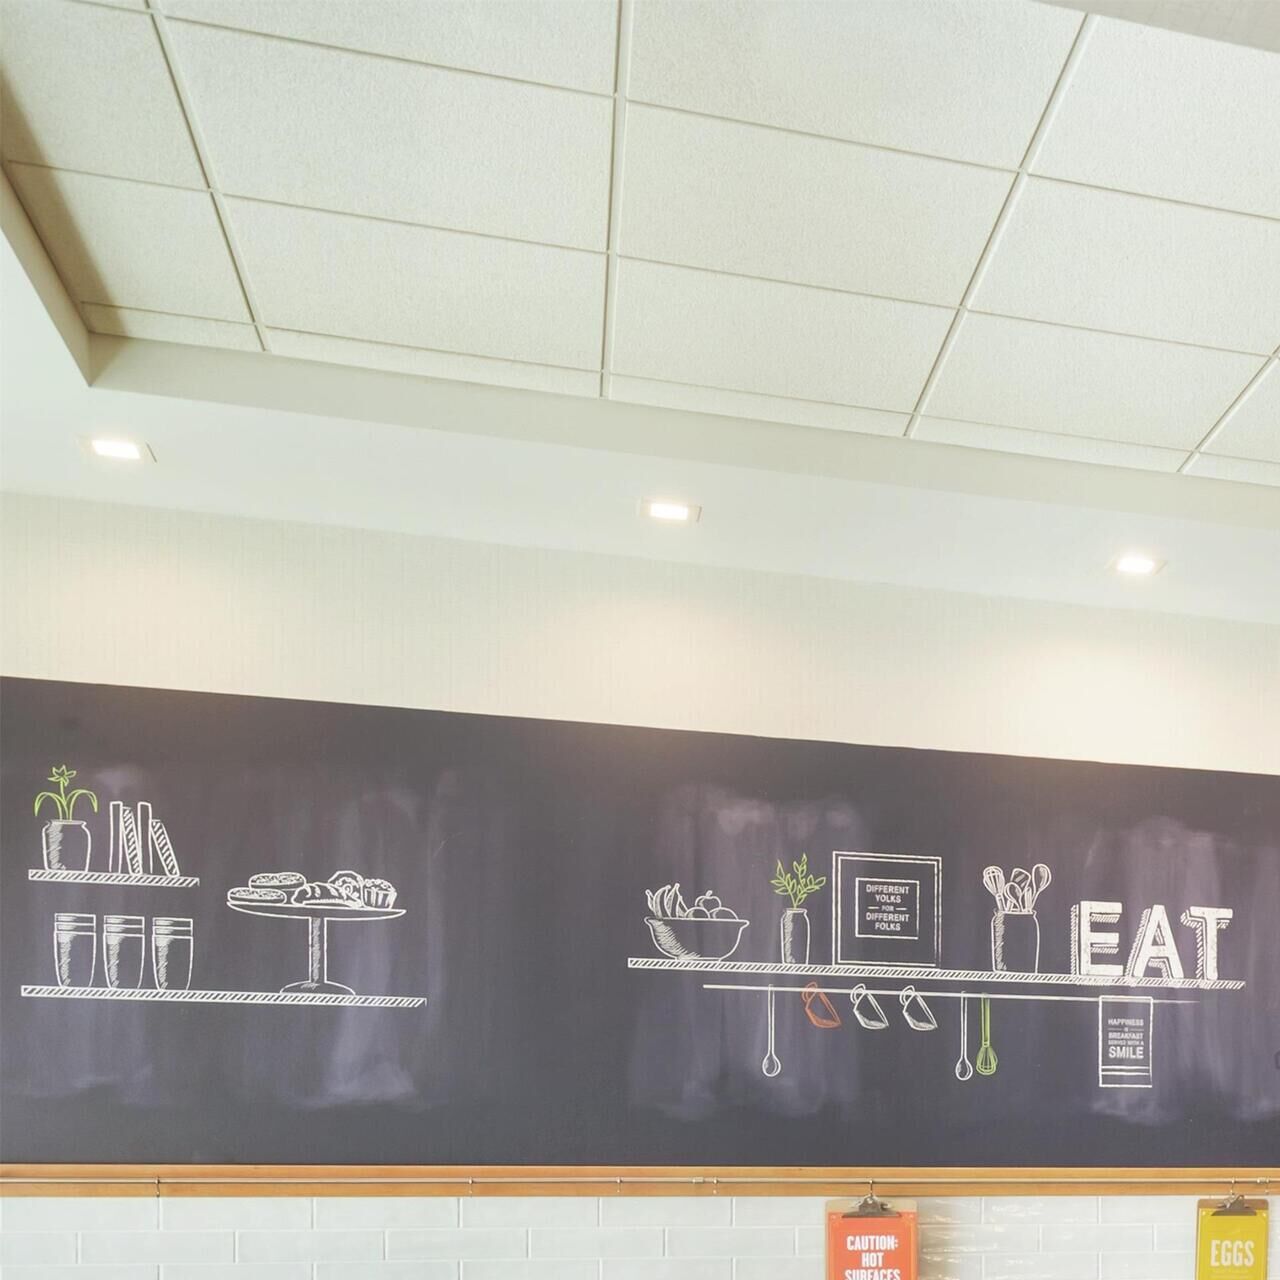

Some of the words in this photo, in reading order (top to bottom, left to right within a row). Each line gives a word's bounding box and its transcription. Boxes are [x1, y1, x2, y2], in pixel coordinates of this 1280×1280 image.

[865, 884, 910, 894] DIFFERENT
[875, 895, 901, 903] YOLKS
[865, 912, 910, 922] DIFFERENT
[875, 922, 901, 931] FOLKS
[1071, 900, 1233, 984] EAT
[1108, 1046, 1144, 1059] SMILE
[846, 1235, 899, 1251] CAUTION:
[862, 1252, 884, 1267] HOT
[1210, 1240, 1255, 1267] EGGS
